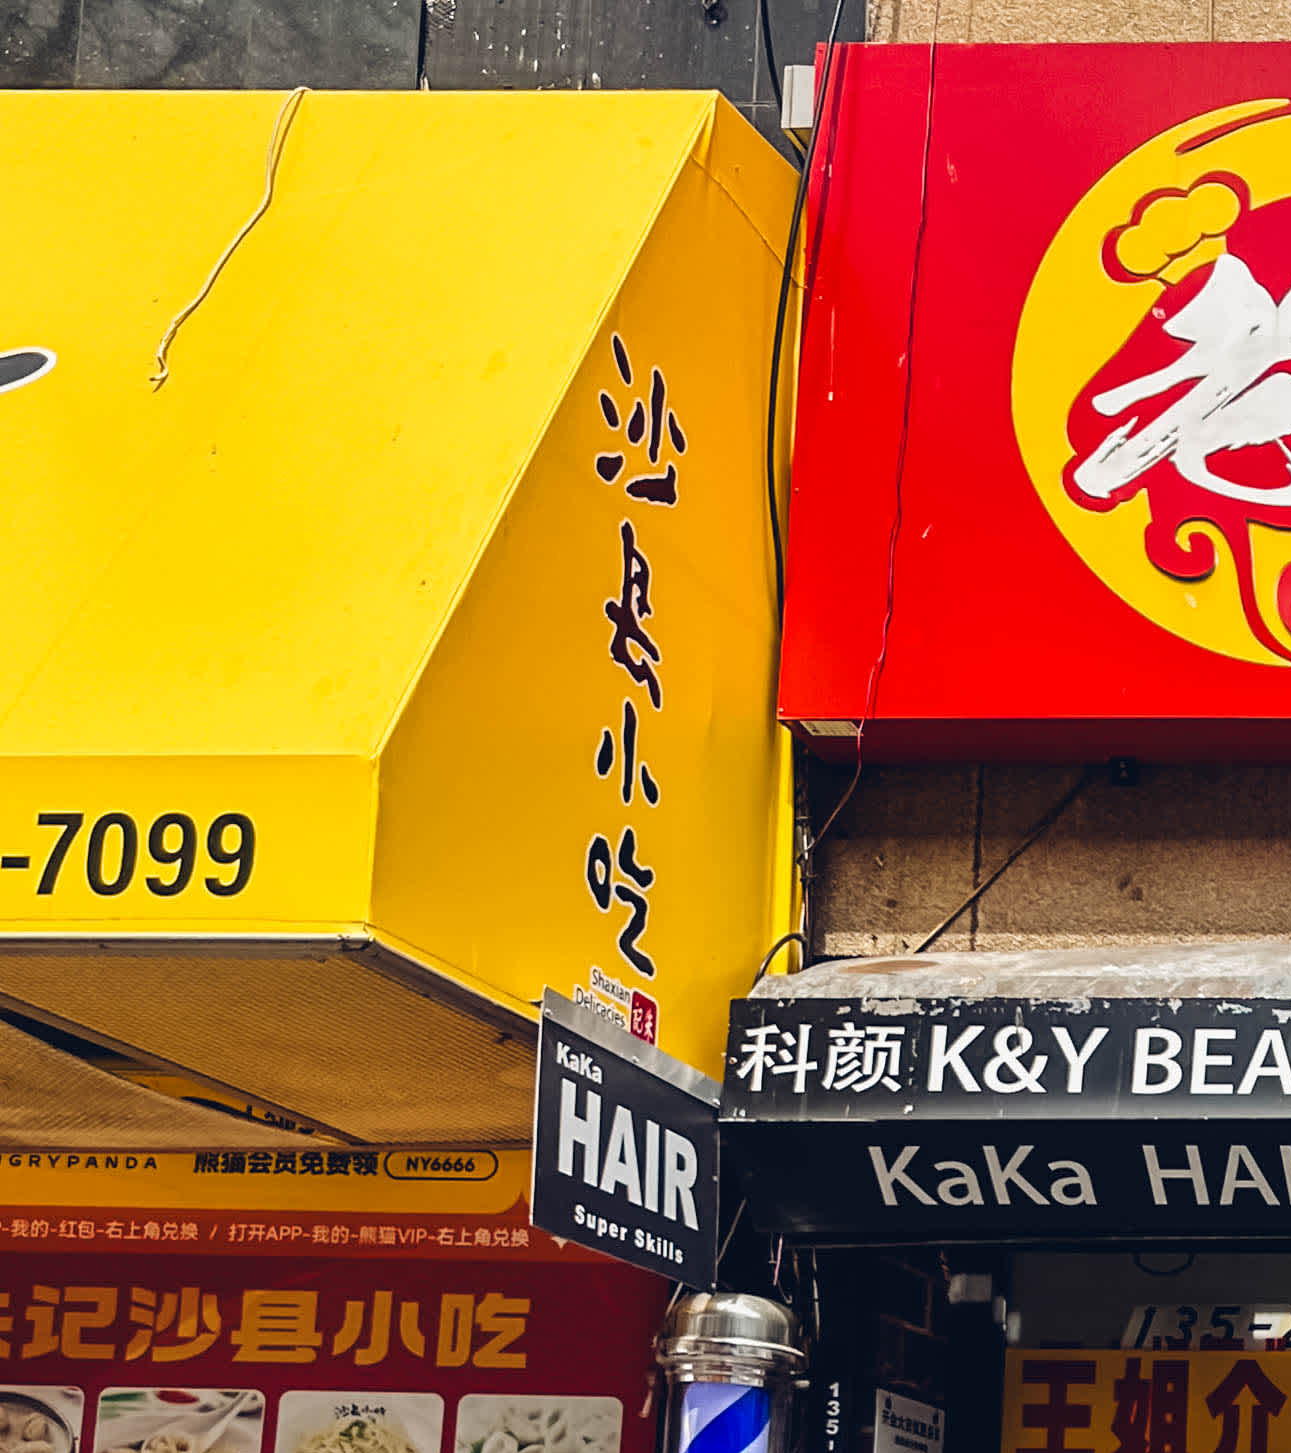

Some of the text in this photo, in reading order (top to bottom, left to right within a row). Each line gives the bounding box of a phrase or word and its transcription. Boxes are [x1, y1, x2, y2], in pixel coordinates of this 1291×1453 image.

[588, 334, 686, 977] 沙县小吃
[0, 812, 257, 897] -7099
[575, 986, 627, 1029] Delicacies
[591, 967, 632, 1003] Shaxian
[557, 1042, 602, 1084] KaKa
[737, 1020, 906, 1094] 科颜
[928, 1024, 1107, 1095] K&Y
[0, 1153, 159, 1170] GRYPANDA
[405, 1156, 476, 1173] NY6666
[557, 1078, 699, 1231] HAIR
[869, 1144, 1097, 1207] KaKa
[0, 1217, 199, 1242] -我的-红包-右上角兑换
[574, 1204, 684, 1263] Super Skills
